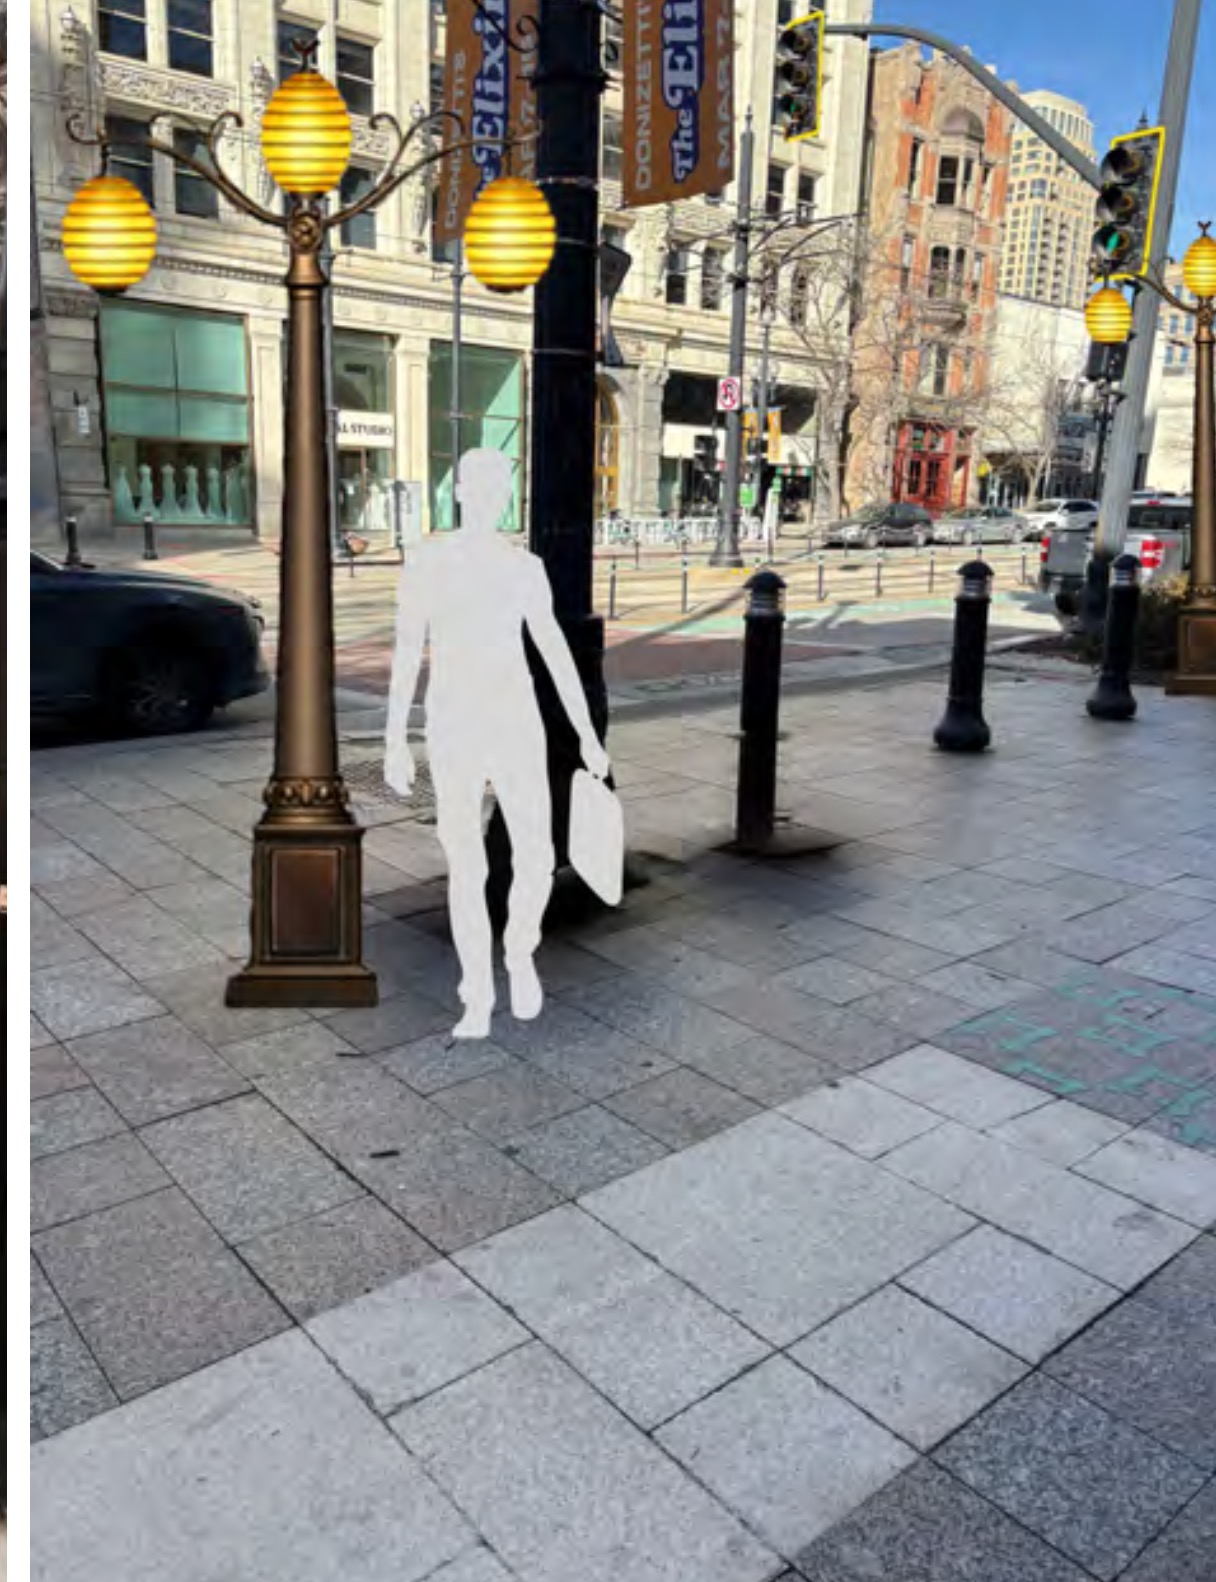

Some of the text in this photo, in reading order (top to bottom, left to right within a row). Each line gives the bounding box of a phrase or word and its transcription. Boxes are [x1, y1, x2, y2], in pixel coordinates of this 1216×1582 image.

[444, 51, 465, 229] DONITTI'S
[669, 109, 694, 181] The
[716, 55, 730, 170] MAR
[350, 423, 392, 437] STUDIO
